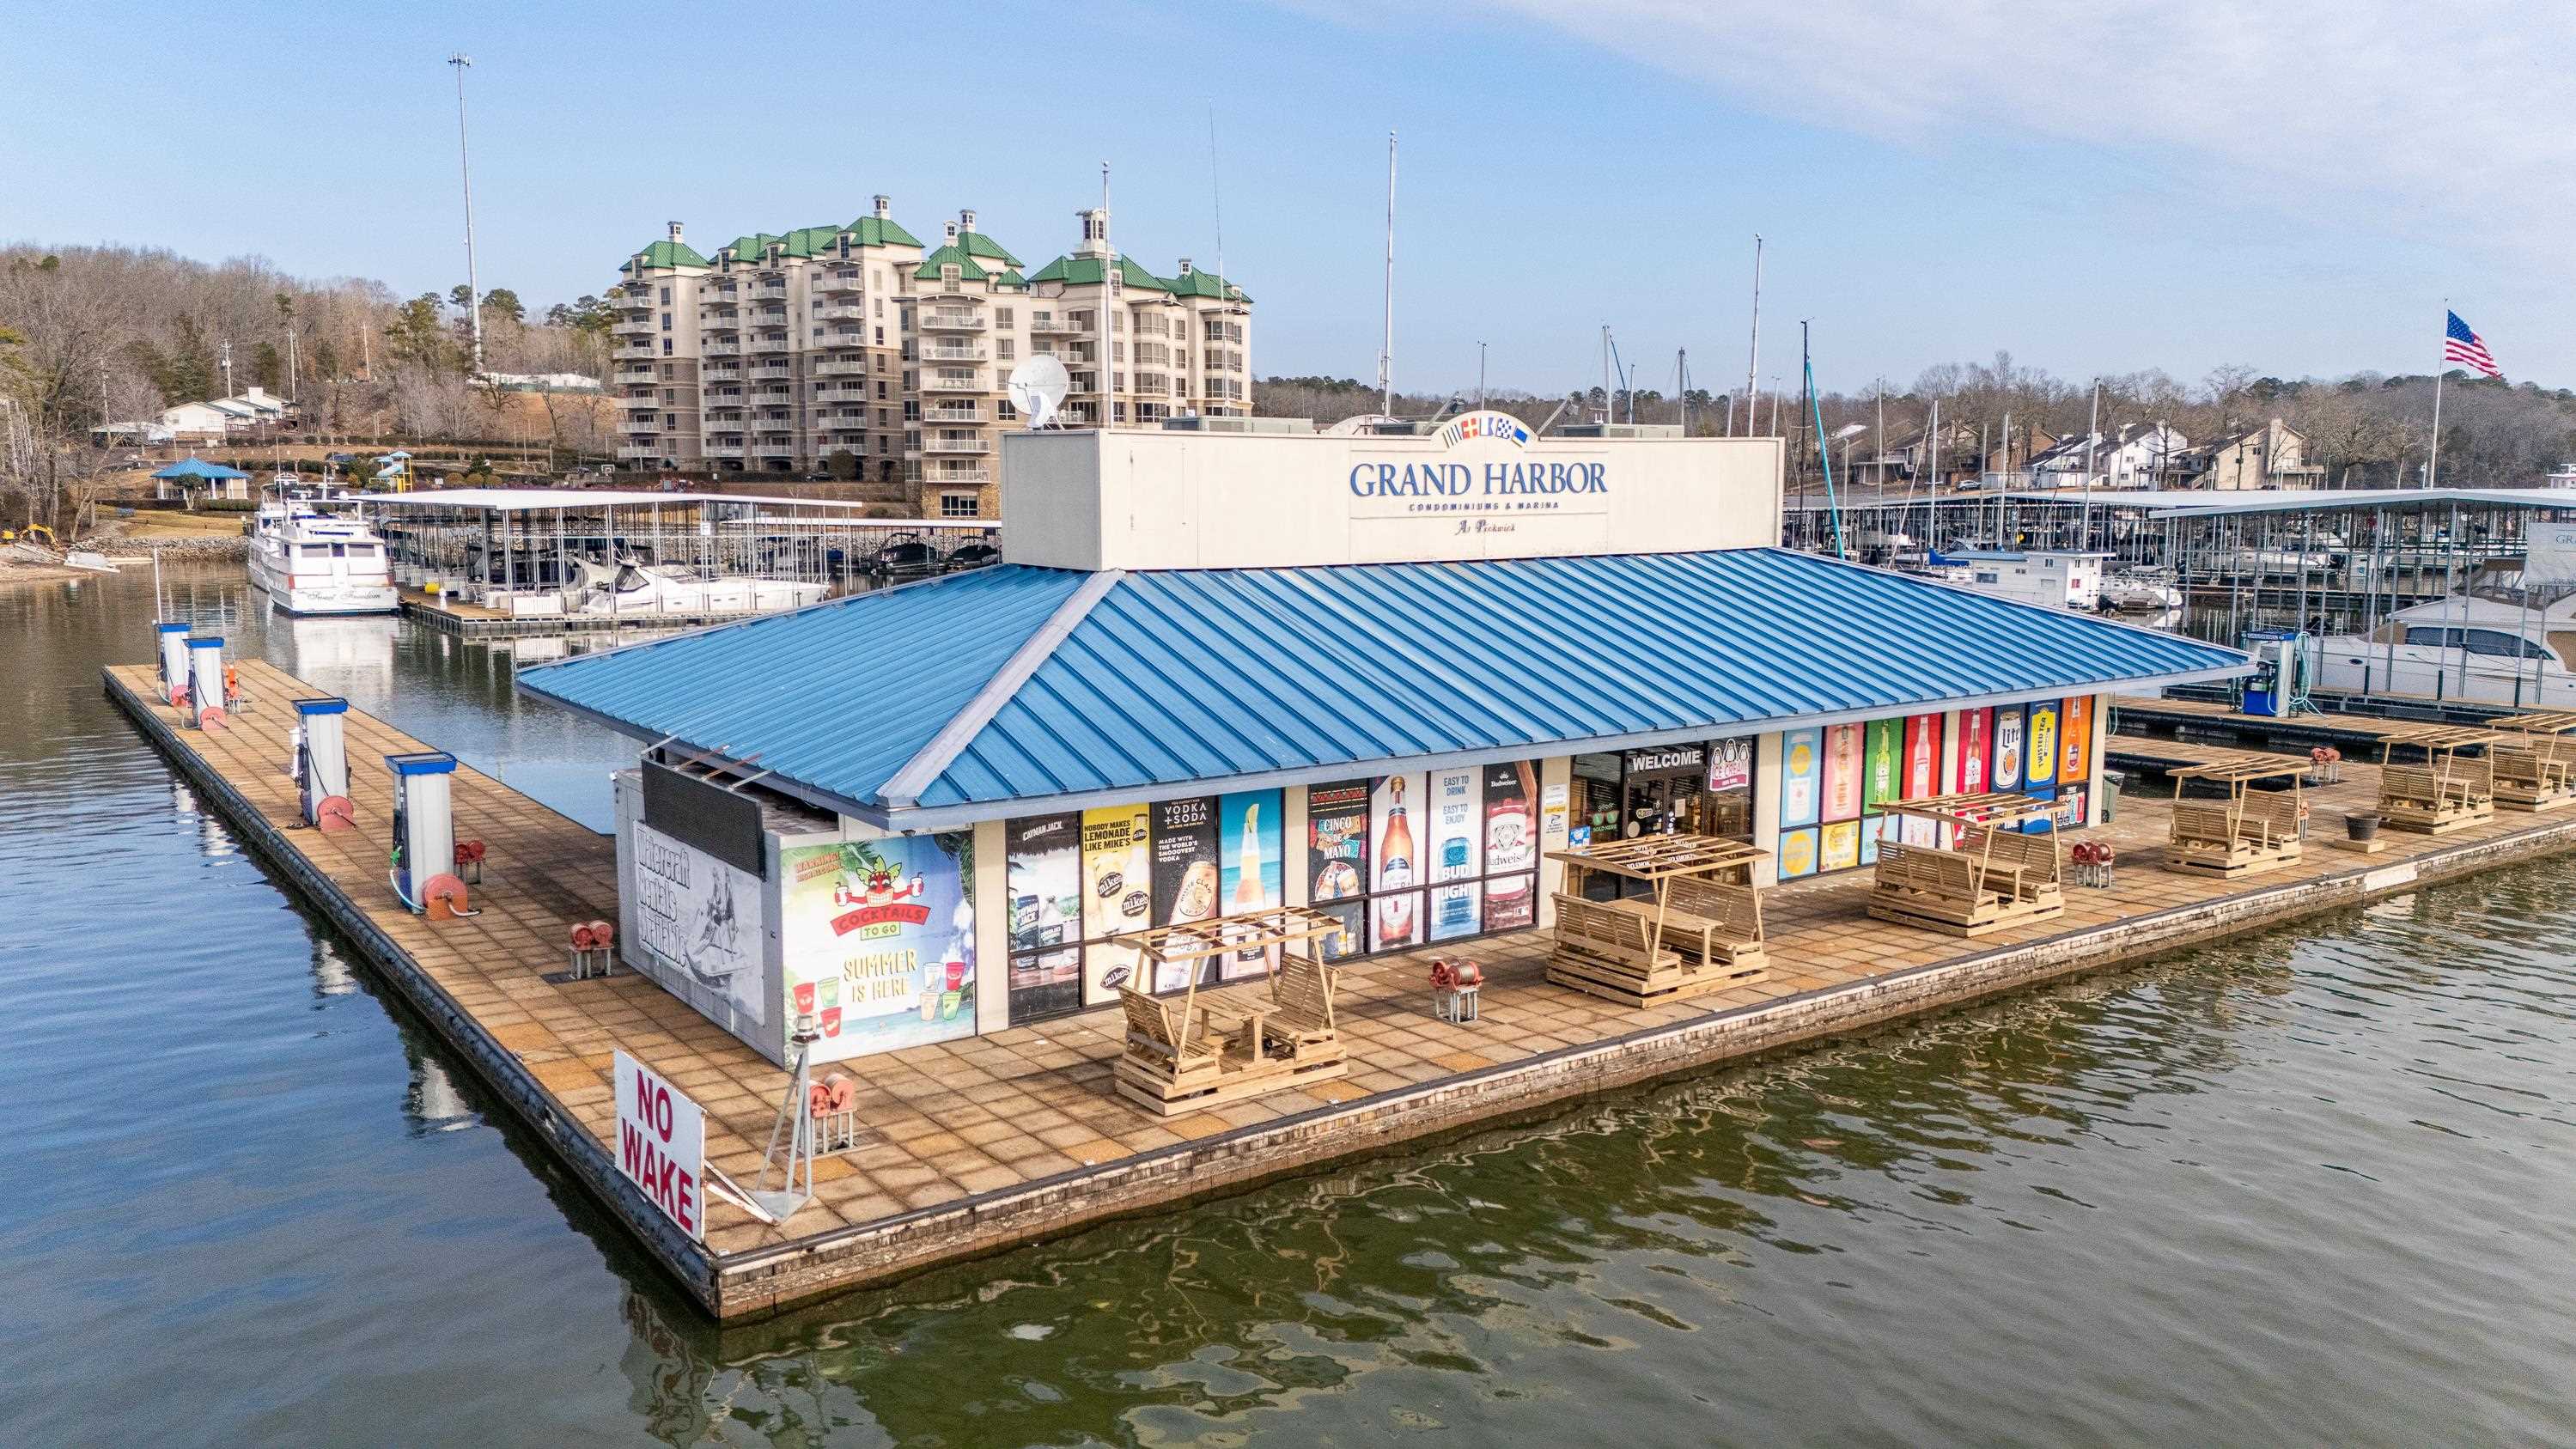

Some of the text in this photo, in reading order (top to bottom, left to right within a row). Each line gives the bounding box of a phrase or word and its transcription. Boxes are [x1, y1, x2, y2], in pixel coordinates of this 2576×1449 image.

[1350, 462, 1609, 497] GRAND HARBOR
[1409, 502, 1499, 512] CONDOMINIUMS
[1517, 502, 1560, 510] MARINA
[1632, 750, 1702, 771] WELCOME
[1443, 775, 1470, 787] EASY TO
[1446, 785, 1466, 796] DRINK
[1164, 802, 1208, 815] VODKA
[1443, 803, 1469, 815] EASY TO
[1084, 819, 1130, 832] NOBODY MAKES
[1324, 816, 1352, 831] CINCO
[1084, 827, 1130, 842] LEMONADE
[1158, 837, 1177, 845] MADE
[1084, 837, 1130, 852] LIKE MIKE'S
[1324, 843, 1351, 859] MAYO
[1158, 855, 1180, 863] VODKA
[1443, 864, 1470, 880] BUD
[838, 907, 923, 930] COCKTAILS
[864, 924, 898, 936] TO GO
[843, 947, 917, 982] SUMMER
[852, 977, 910, 1003] IS HERE
[637, 1068, 673, 1144] NO
[622, 1117, 693, 1234] WAKE
